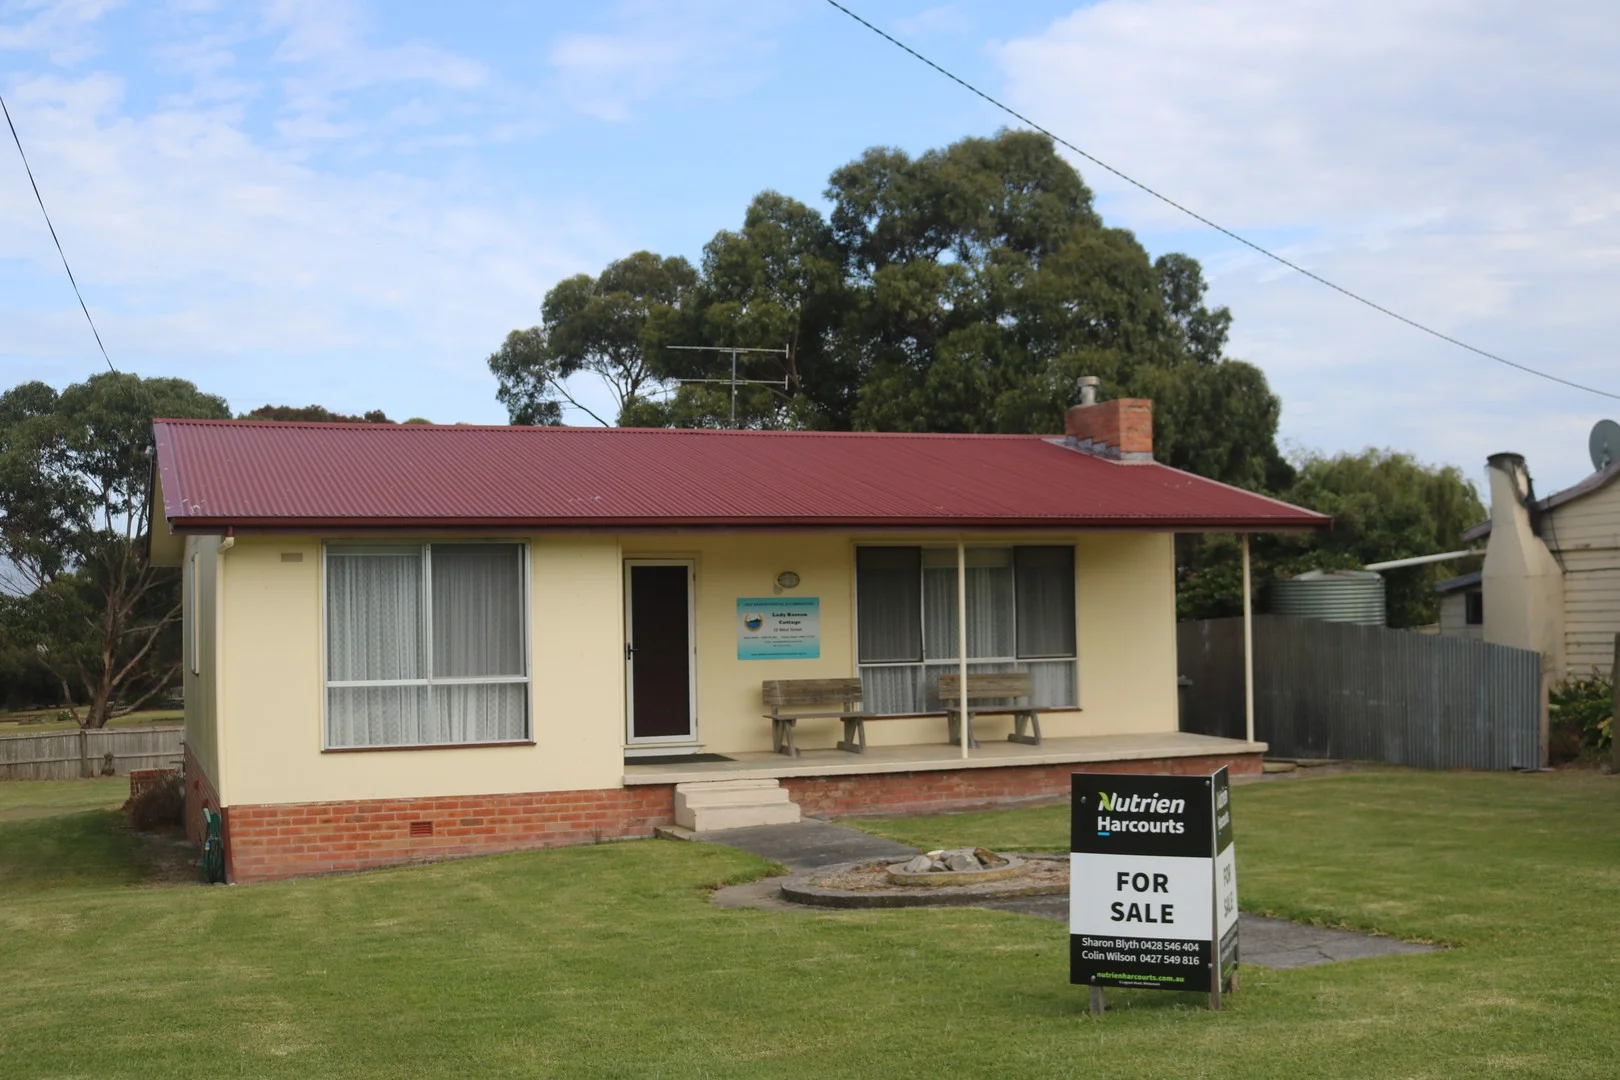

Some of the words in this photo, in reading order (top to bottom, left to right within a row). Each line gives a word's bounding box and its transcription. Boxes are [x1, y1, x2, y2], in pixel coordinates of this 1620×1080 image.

[1098, 791, 1185, 814] Nutrien
[1097, 816, 1184, 834] Harcourts
[1117, 872, 1168, 893] FOR
[1110, 902, 1174, 923] SALE
[1082, 938, 1114, 948] Sharon
[1115, 939, 1139, 951] Blyth
[1140, 940, 1163, 950] 0428
[1164, 941, 1181, 951] 546
[1182, 943, 1199, 951] 404
[1082, 951, 1105, 961] Colin
[1106, 952, 1136, 962] Wilson
[1139, 954, 1161, 963] 0427
[1164, 955, 1181, 964] 549
[1182, 957, 1199, 965] 816
[1096, 972, 1184, 982] nutrienharcourts.com.au
